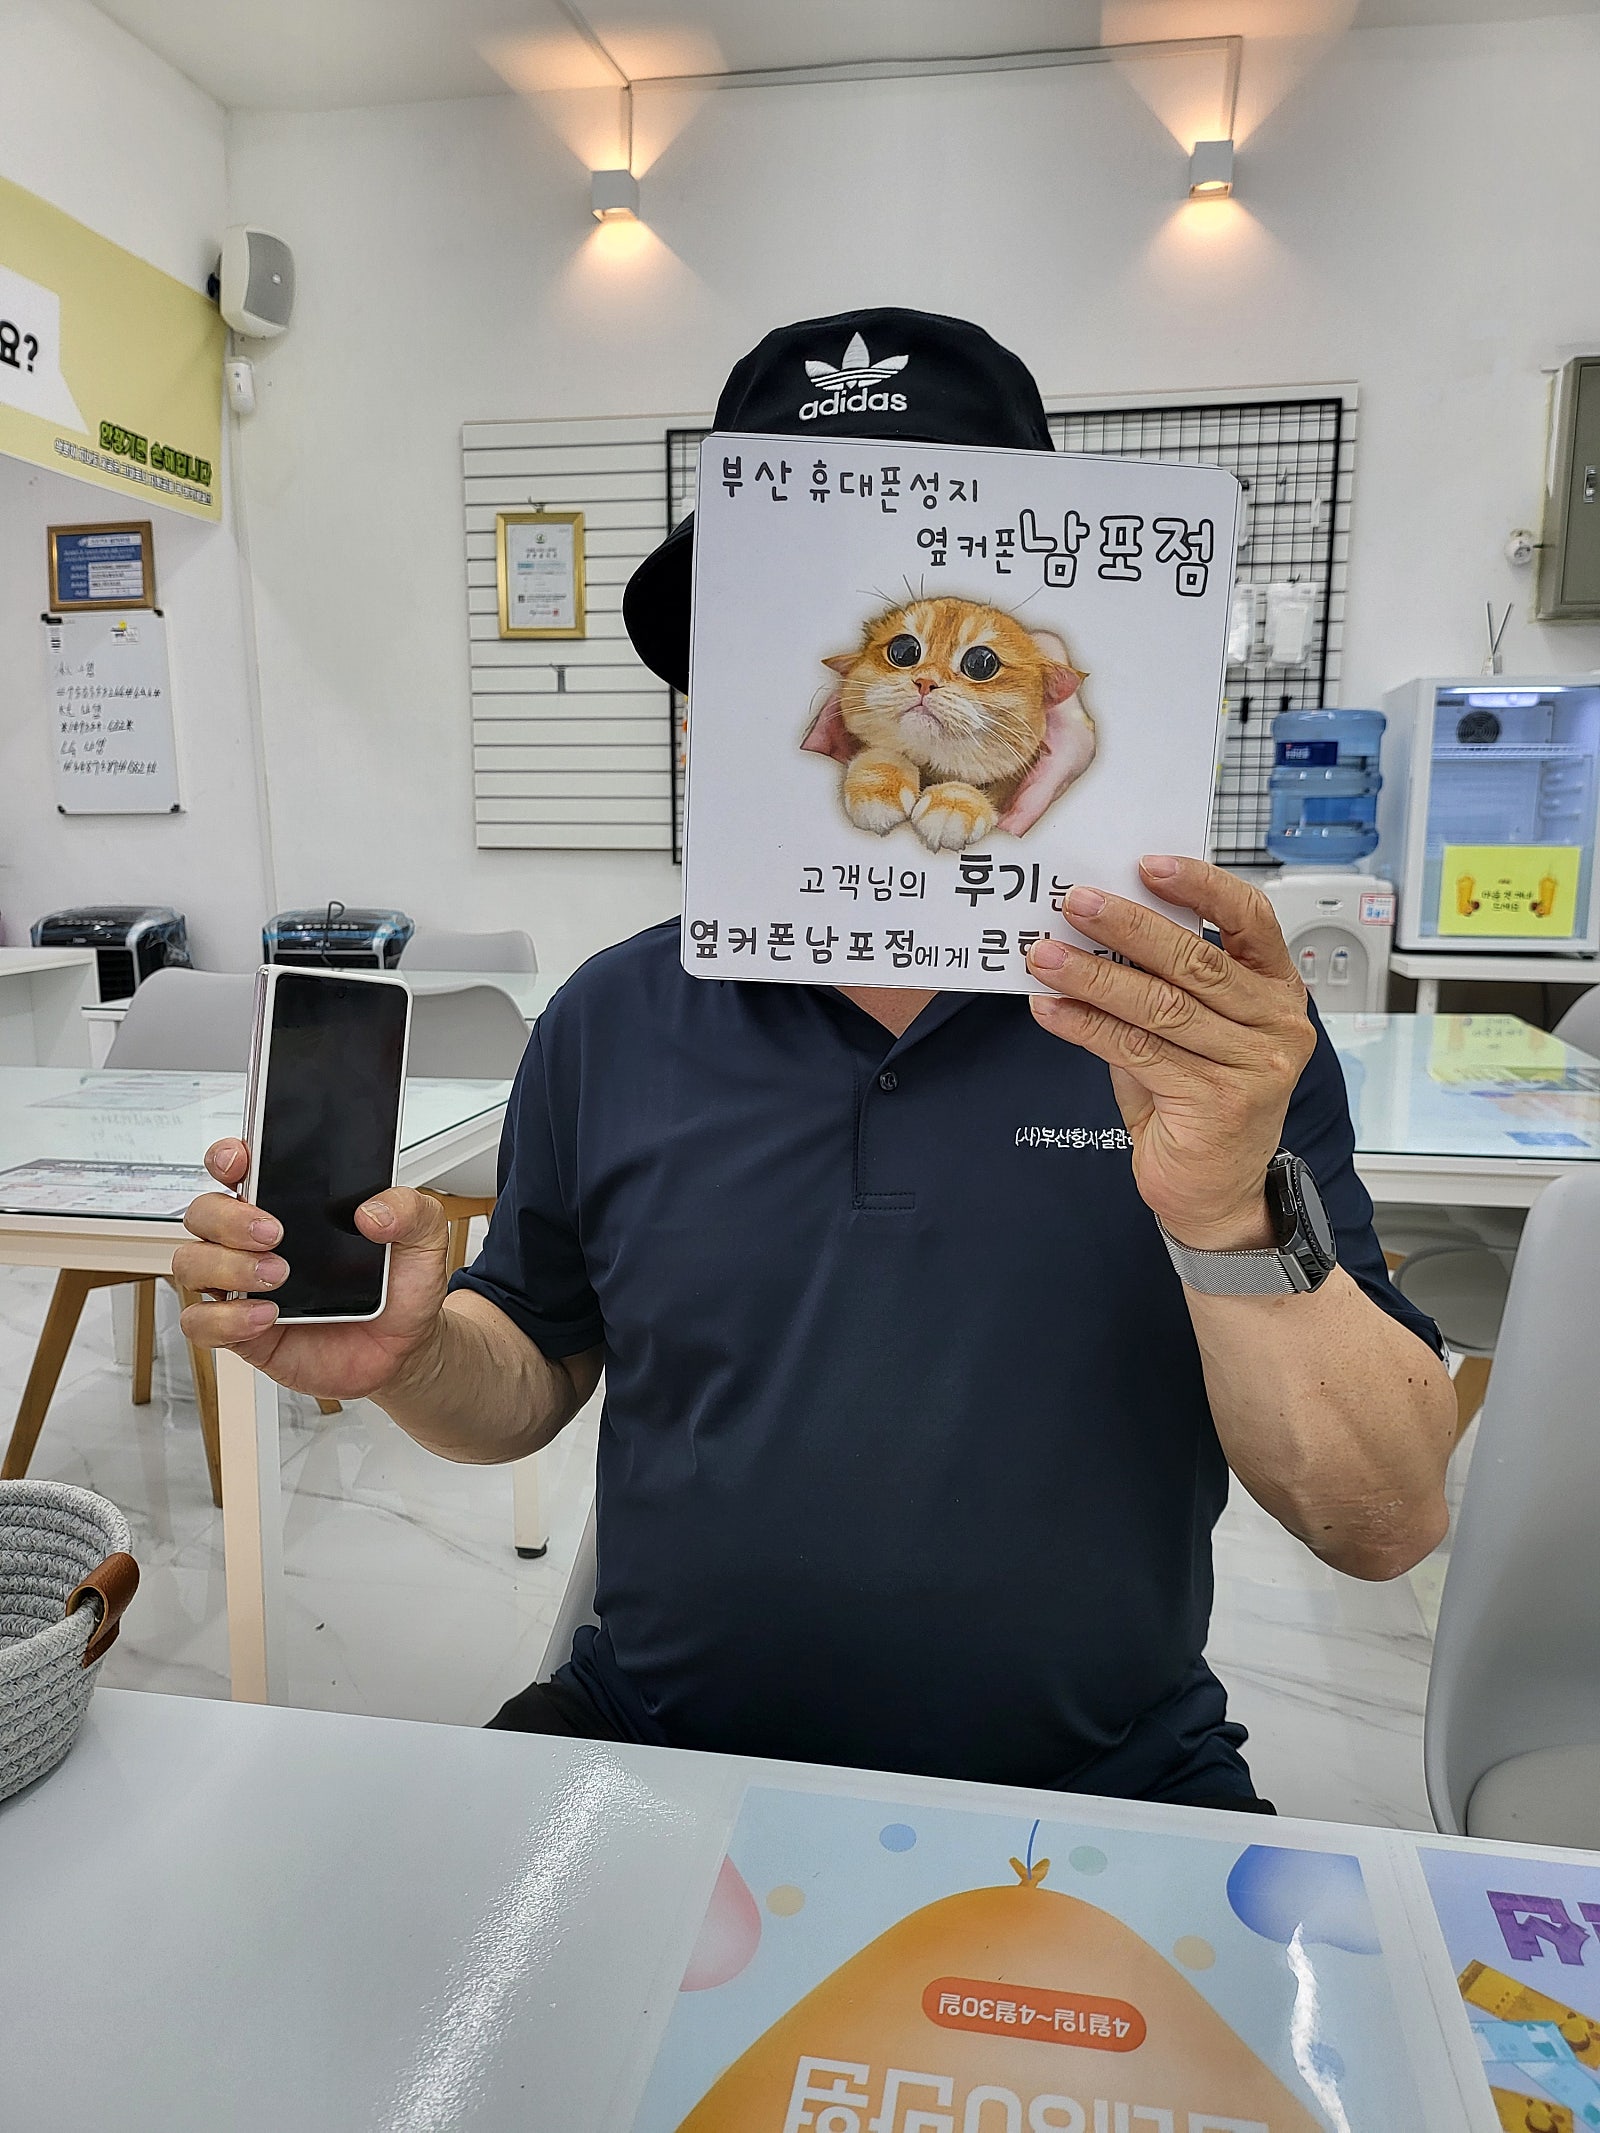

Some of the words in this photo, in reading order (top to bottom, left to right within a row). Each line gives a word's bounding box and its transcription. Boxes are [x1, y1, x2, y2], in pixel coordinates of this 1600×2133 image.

[799, 388, 908, 421] adidas
[722, 456, 792, 502] 부산
[800, 864, 926, 901] 고객님의
